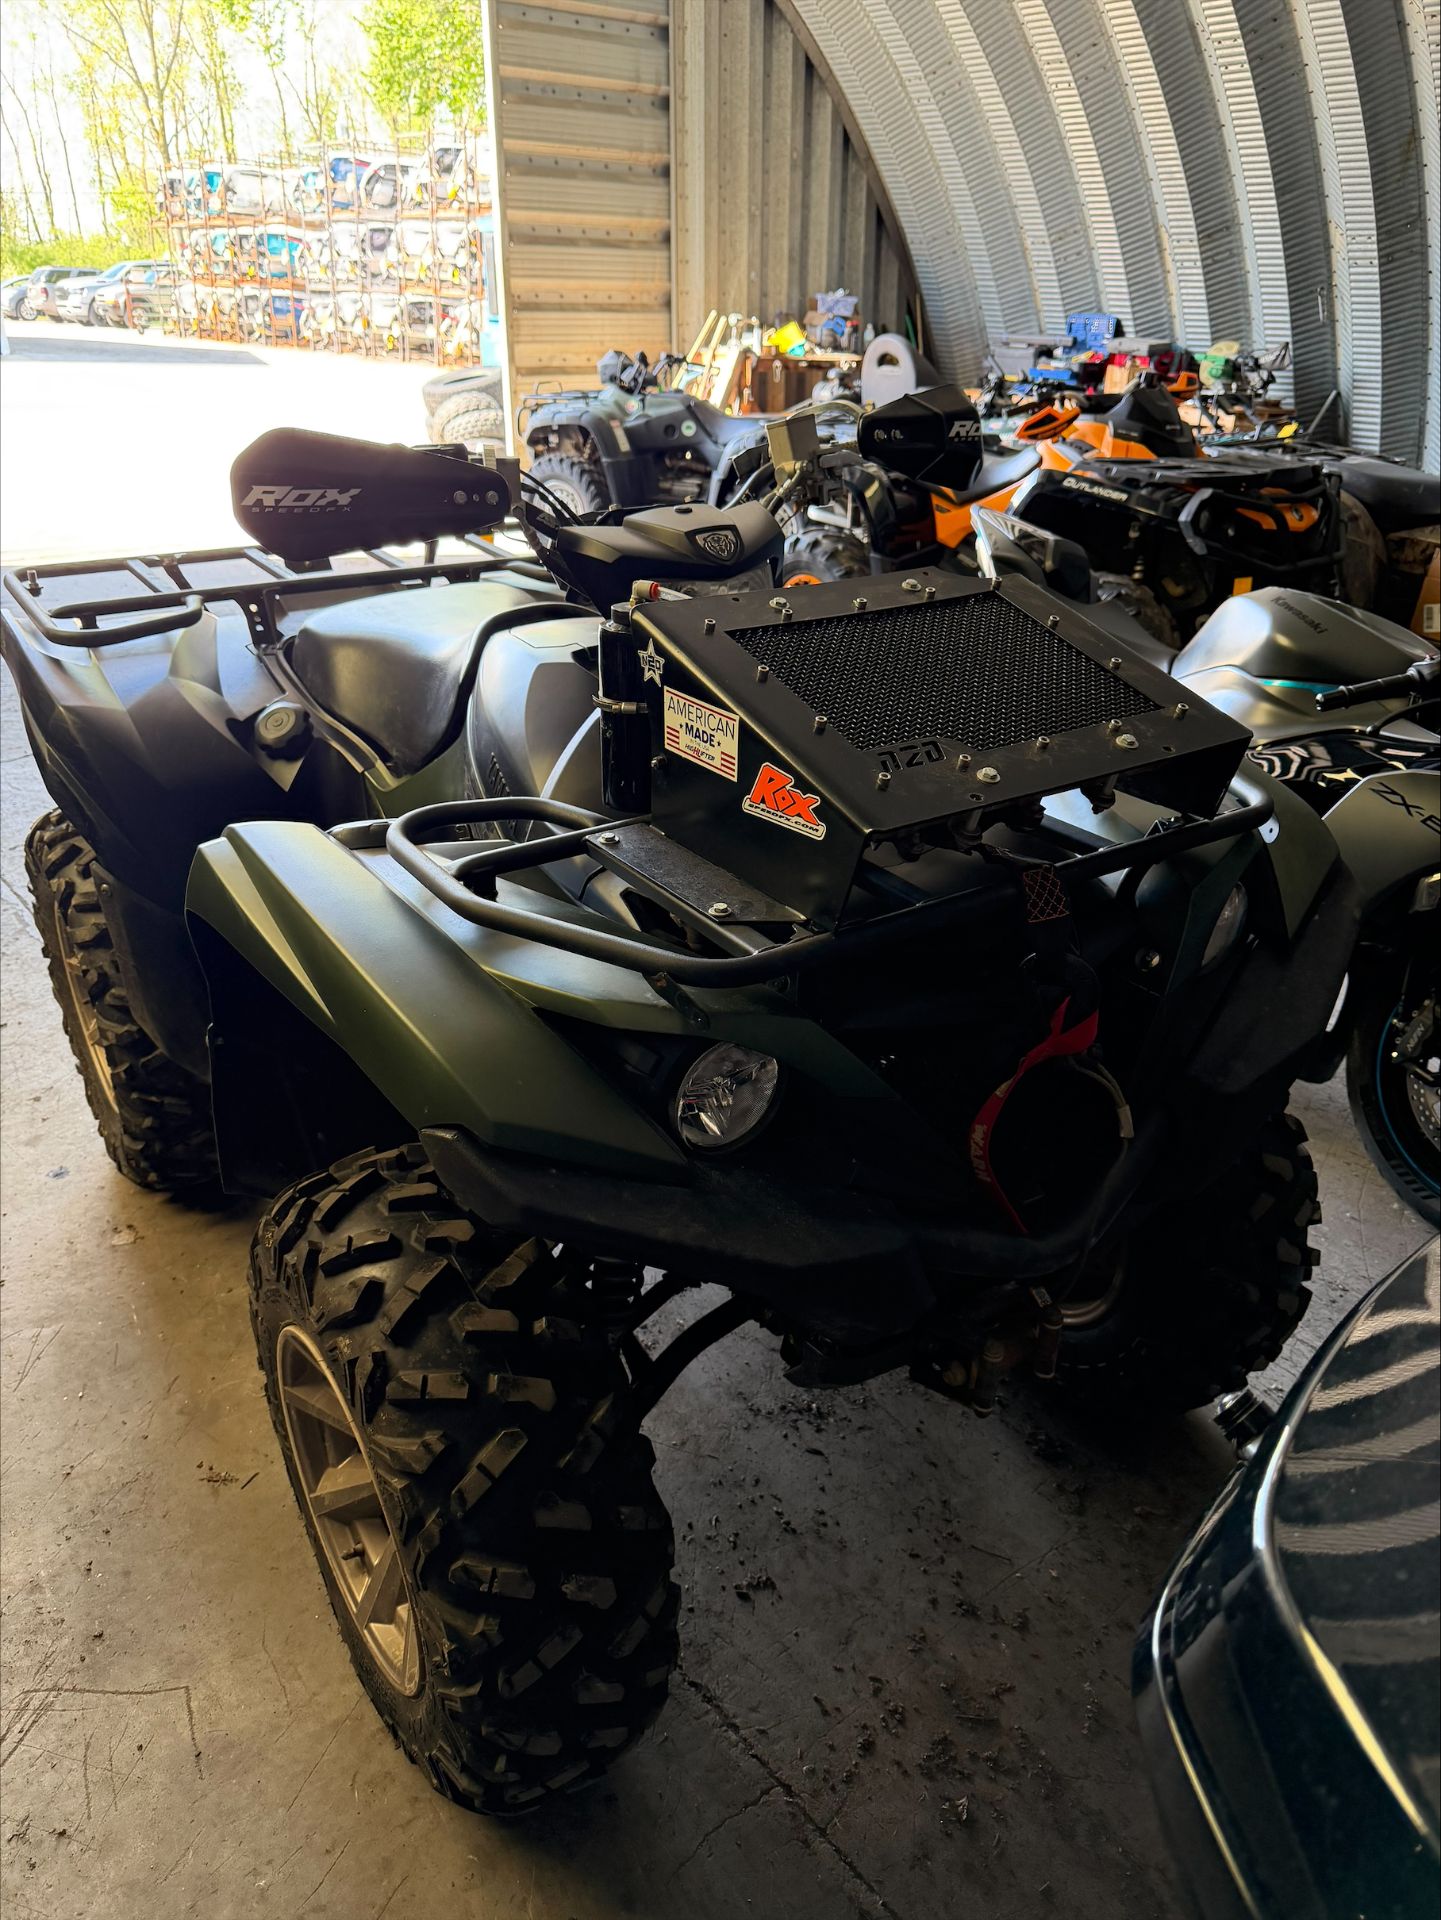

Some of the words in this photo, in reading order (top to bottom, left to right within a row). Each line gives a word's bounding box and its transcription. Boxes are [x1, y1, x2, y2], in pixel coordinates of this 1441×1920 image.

[949, 420, 982, 438] RO
[240, 485, 363, 506] ROX
[1062, 476, 1129, 502] OUTLANDER
[1271, 596, 1328, 634] Kawasaki
[667, 696, 736, 741] AMERICAN
[684, 722, 716, 748] MADE
[748, 803, 819, 832] SPEEDFX.COM
